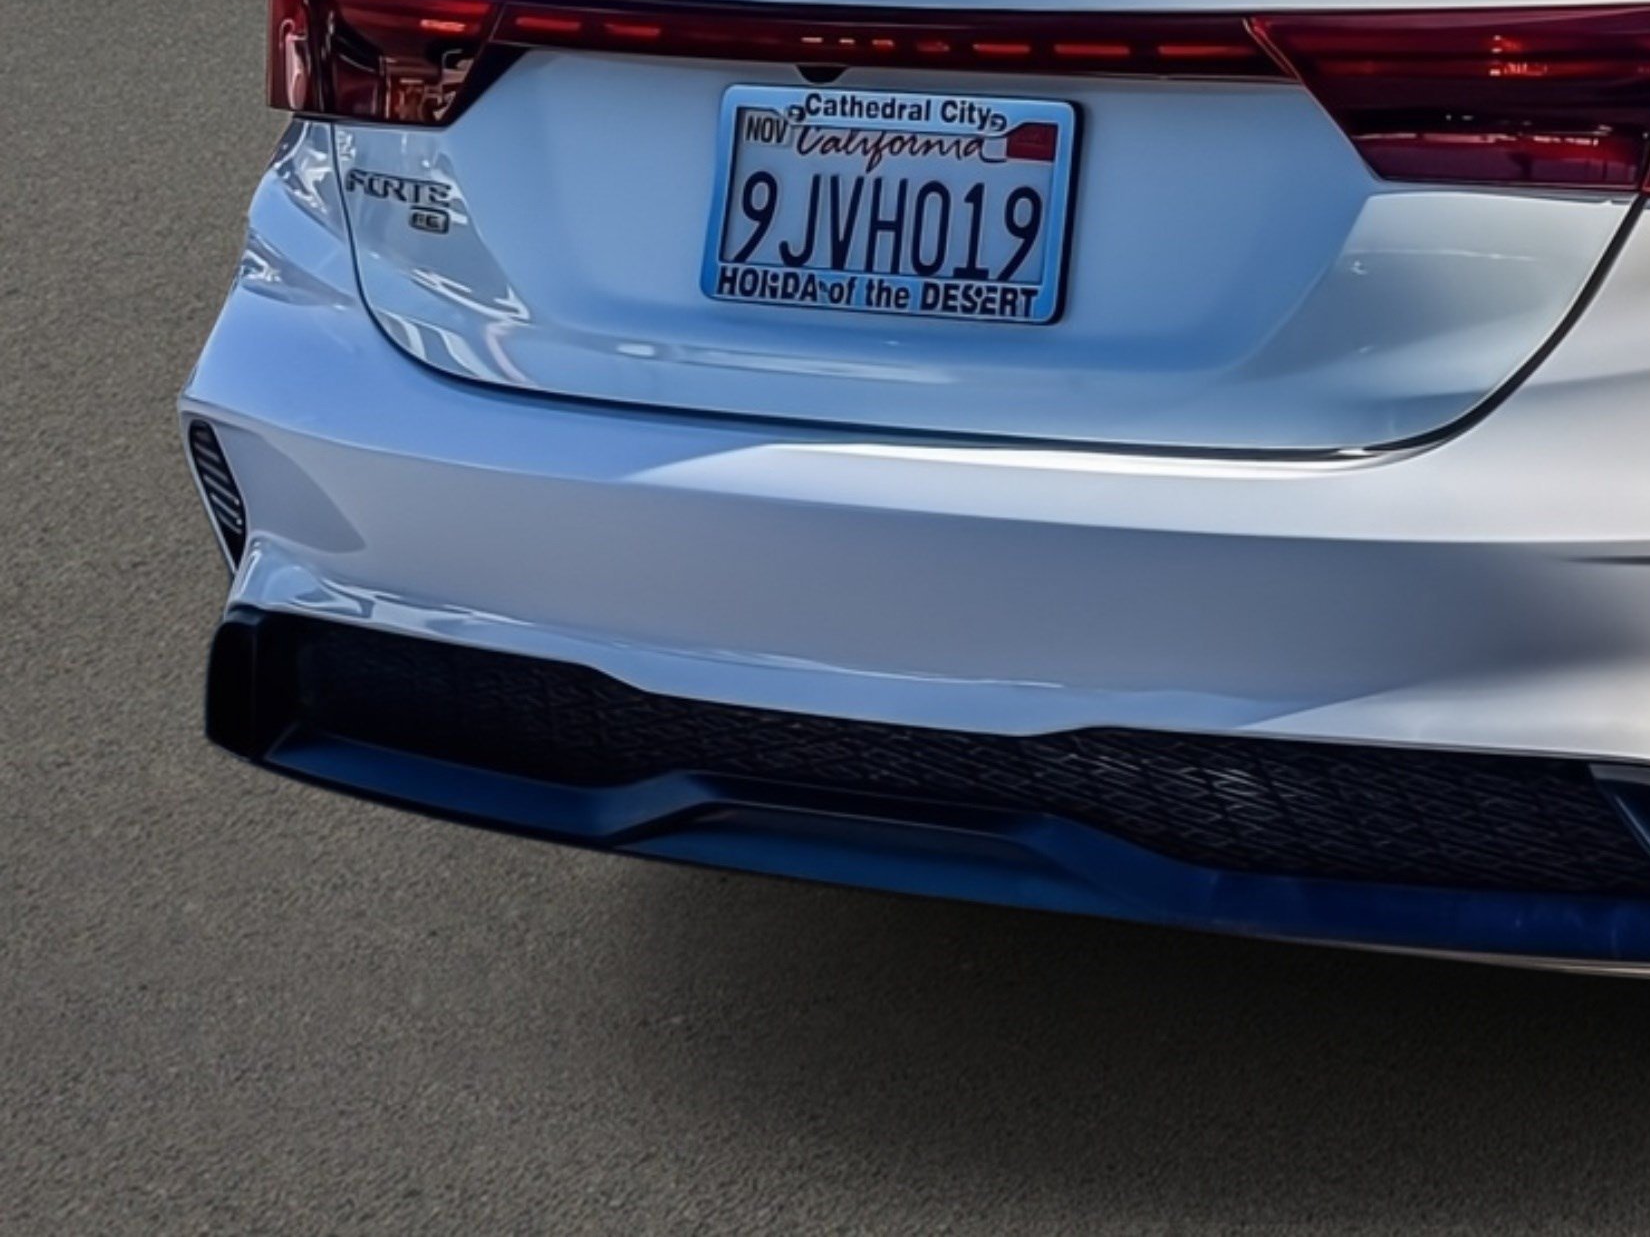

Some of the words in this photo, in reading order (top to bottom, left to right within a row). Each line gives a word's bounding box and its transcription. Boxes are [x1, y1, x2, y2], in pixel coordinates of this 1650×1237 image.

[745, 117, 786, 144] NOV
[804, 93, 931, 122] Cathedral
[939, 103, 990, 130] City
[796, 126, 1006, 172] California
[733, 171, 1043, 281] 9JVH019
[716, 265, 821, 302] HONDA
[826, 277, 856, 306] of
[864, 279, 911, 310] the
[919, 282, 1039, 318] DESERT
